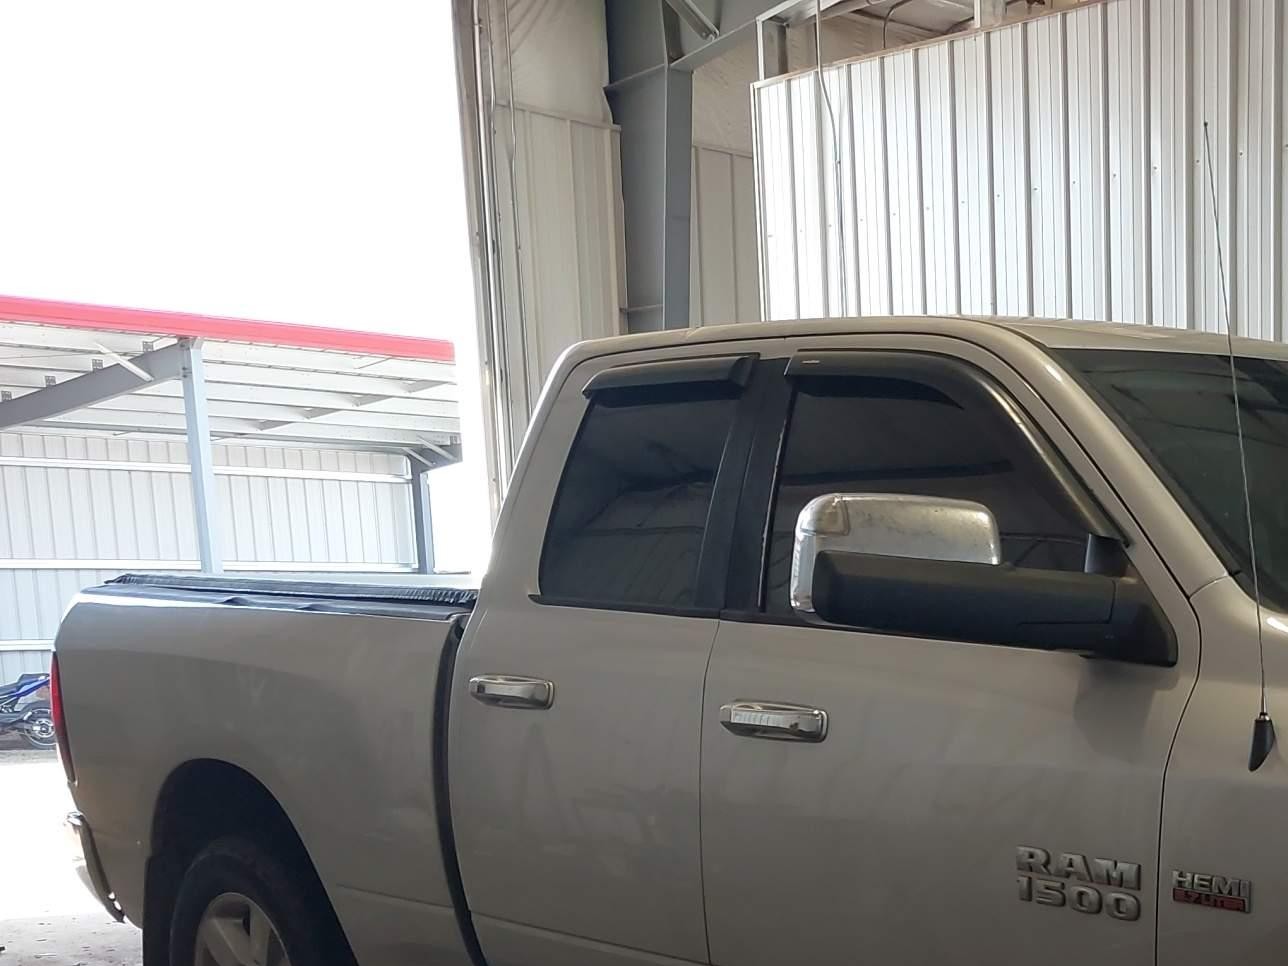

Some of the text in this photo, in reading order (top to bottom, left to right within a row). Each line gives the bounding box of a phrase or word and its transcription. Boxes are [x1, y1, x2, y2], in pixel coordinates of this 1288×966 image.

[1016, 845, 1141, 891] RAM
[1172, 870, 1251, 902] HEMI
[1017, 875, 1141, 921] 1500
